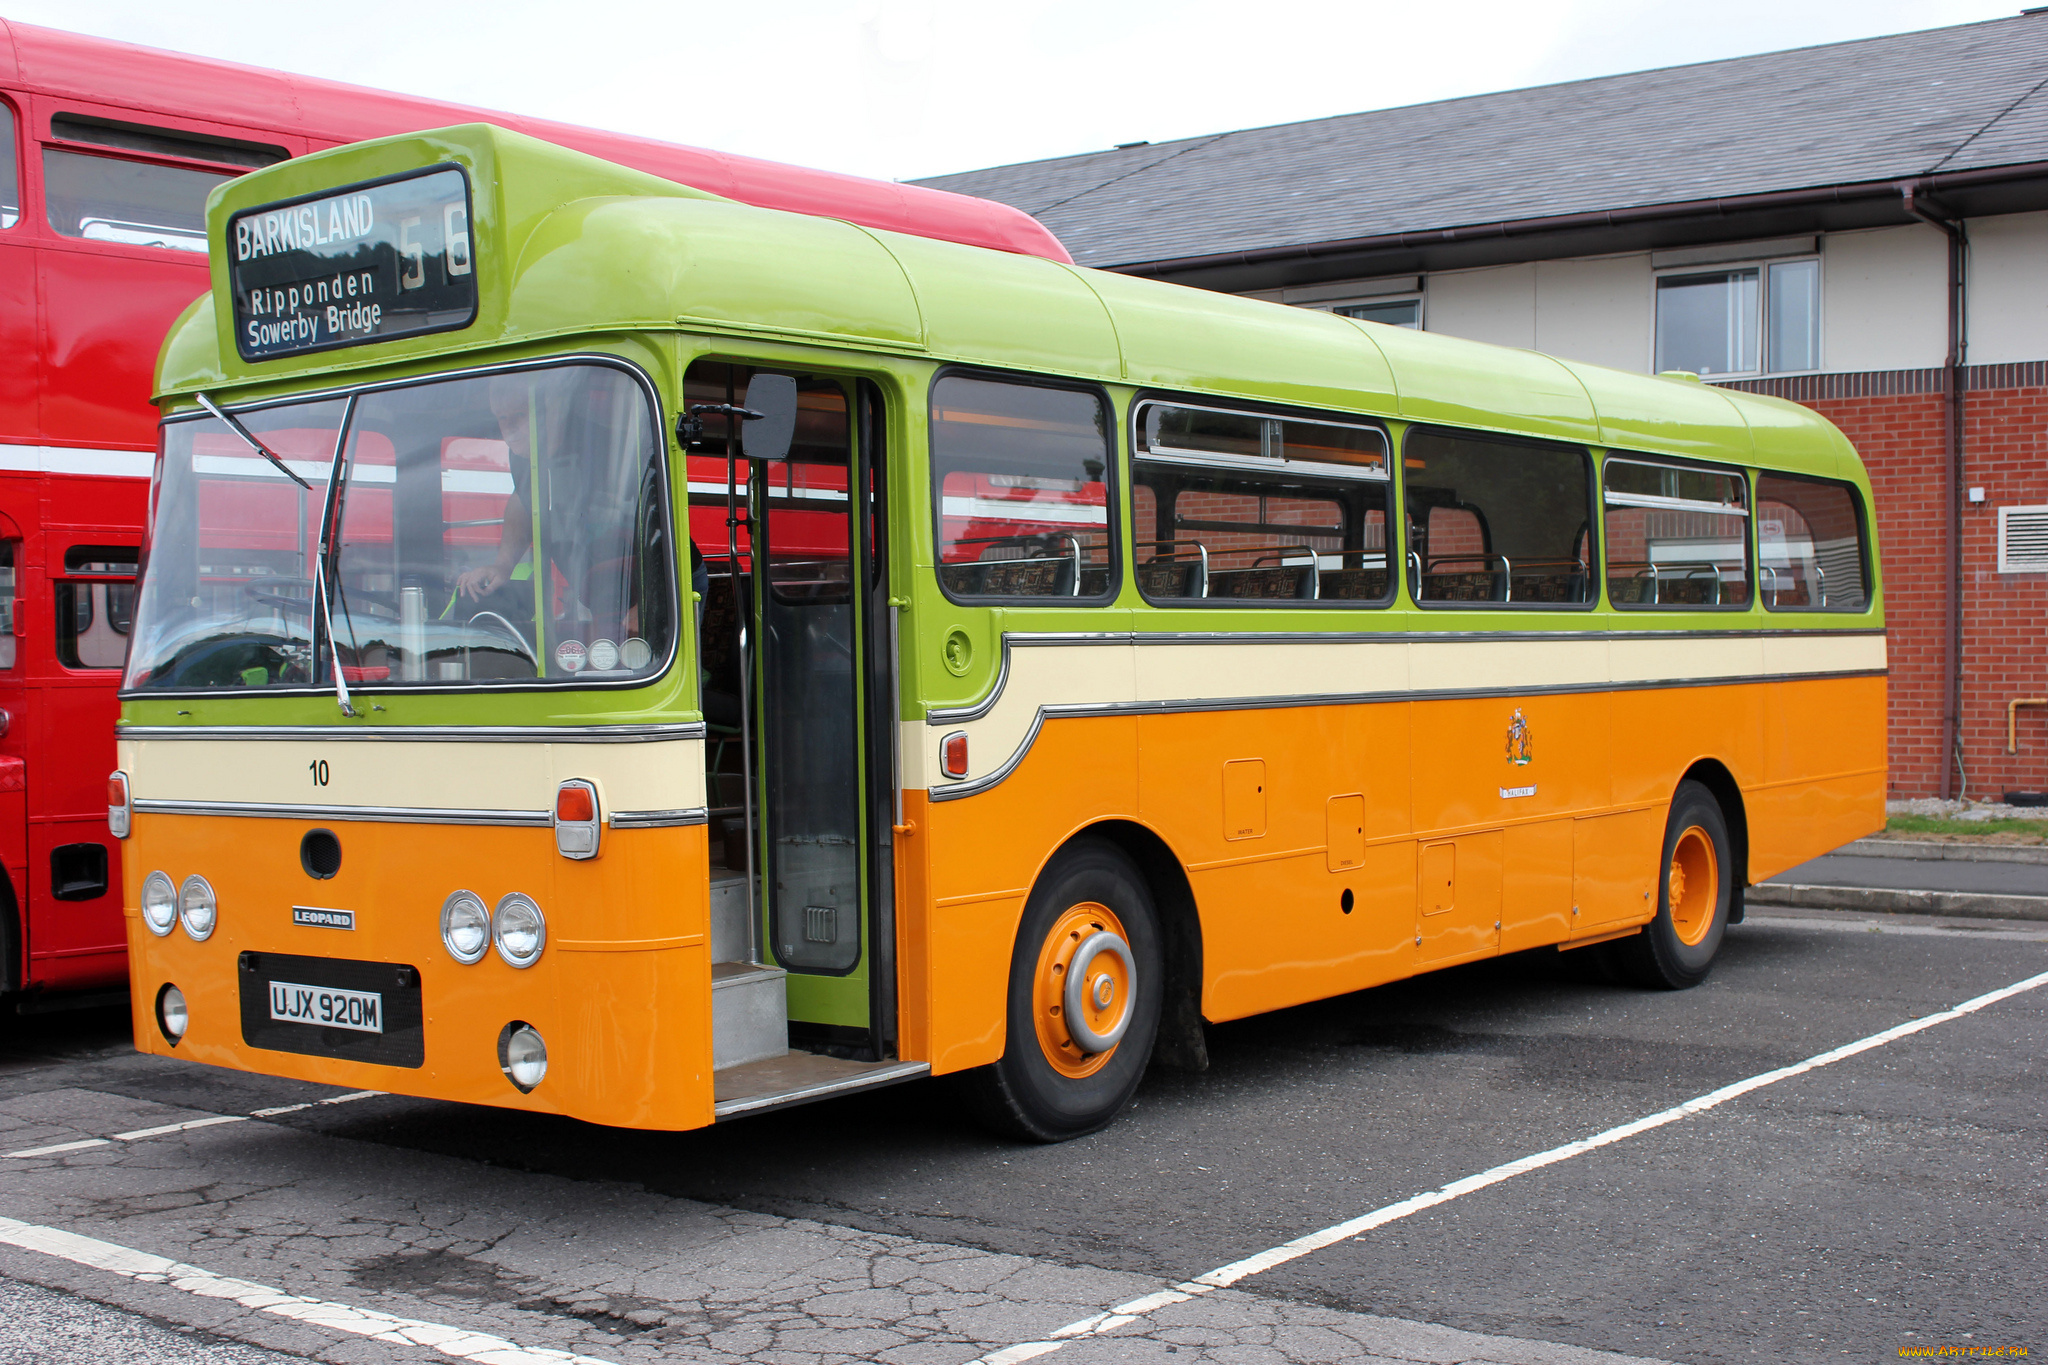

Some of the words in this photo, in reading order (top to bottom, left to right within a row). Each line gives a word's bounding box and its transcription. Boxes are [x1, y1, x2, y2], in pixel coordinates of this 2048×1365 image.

[235, 195, 374, 261] BARKISLAND
[251, 271, 373, 317] Ripponden
[248, 313, 318, 347] Sowerby
[327, 302, 381, 334] Bridge
[309, 760, 329, 786] 10
[294, 911, 351, 926] LEOPARD
[273, 987, 314, 1019] UJX
[320, 994, 378, 1027] 920M
